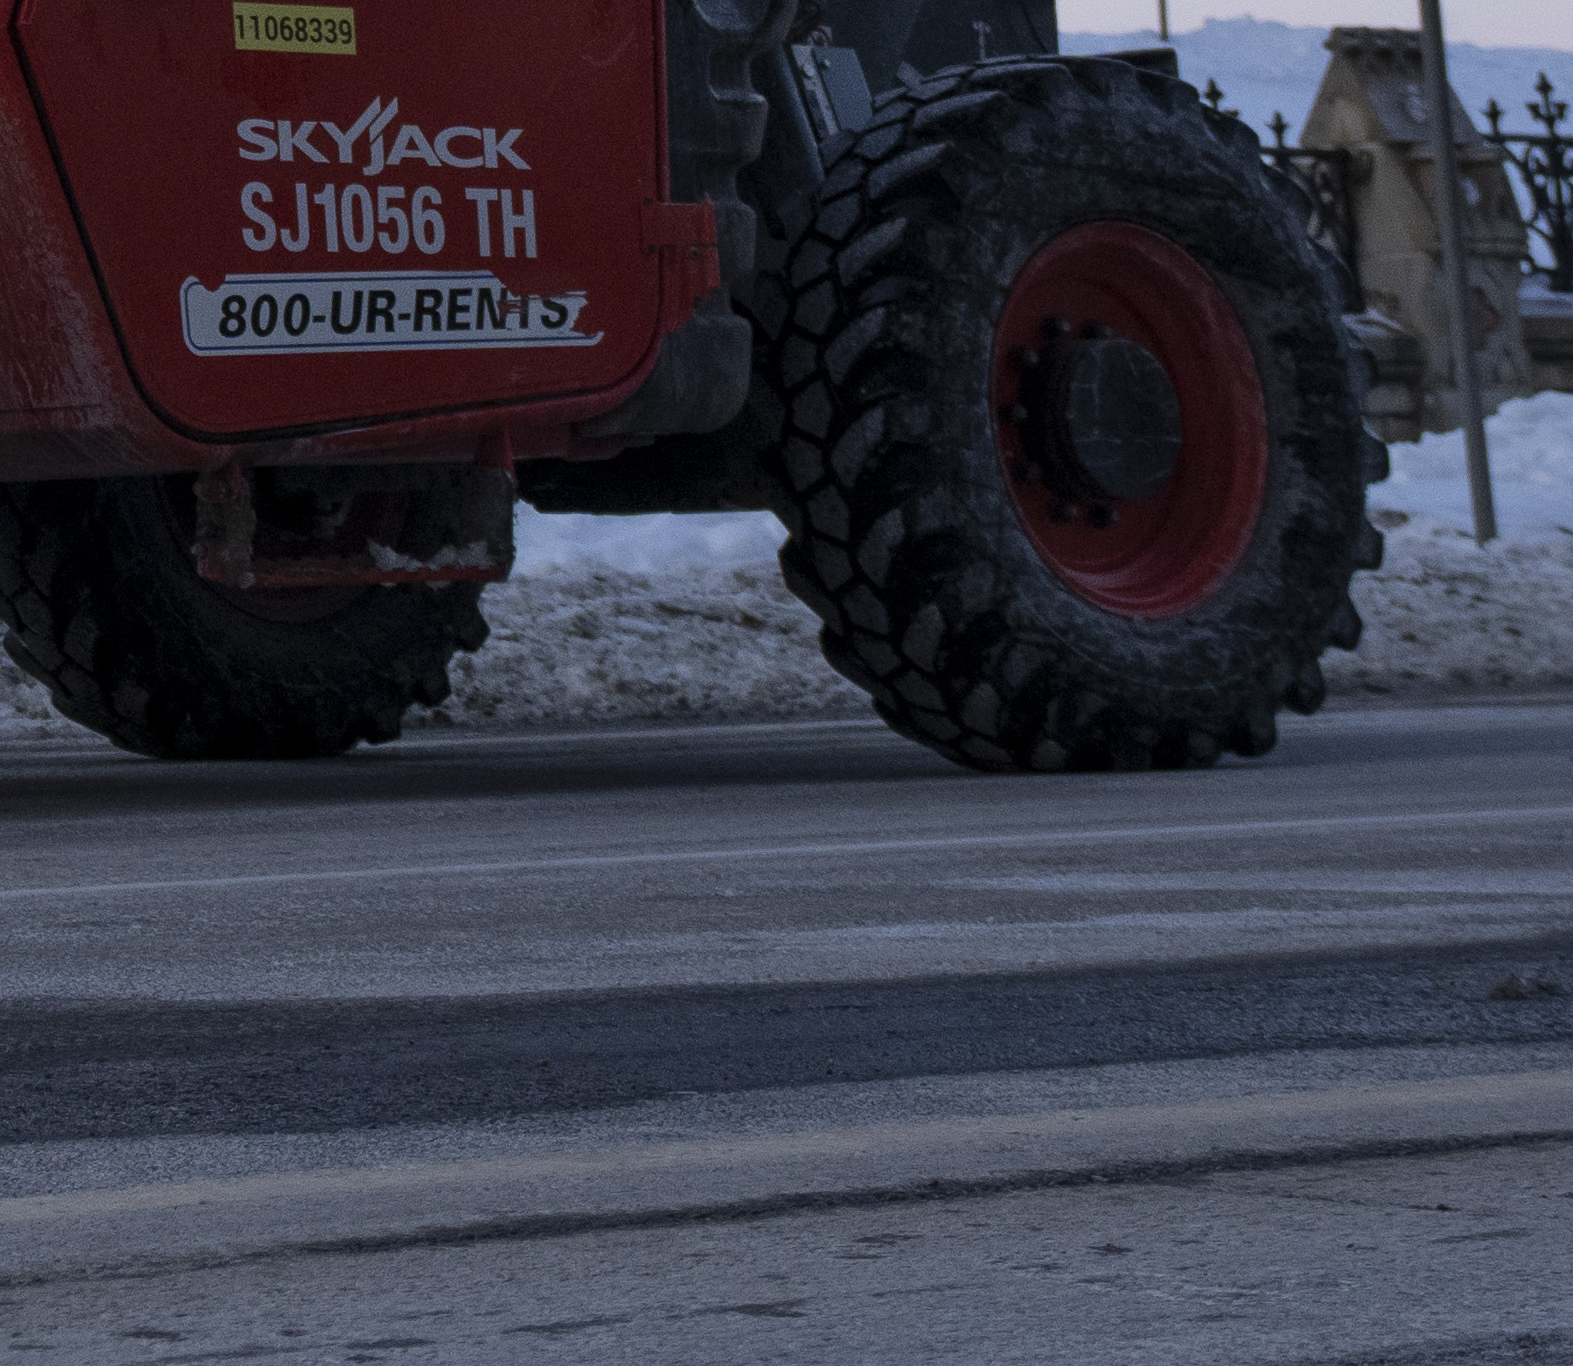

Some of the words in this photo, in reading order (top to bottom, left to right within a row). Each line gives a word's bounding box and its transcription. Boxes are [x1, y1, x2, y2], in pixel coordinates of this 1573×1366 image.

[235, 14, 353, 45] 11068339
[237, 96, 532, 175] SKYJACK
[240, 181, 446, 255] SJ1056
[465, 187, 538, 258] TH
